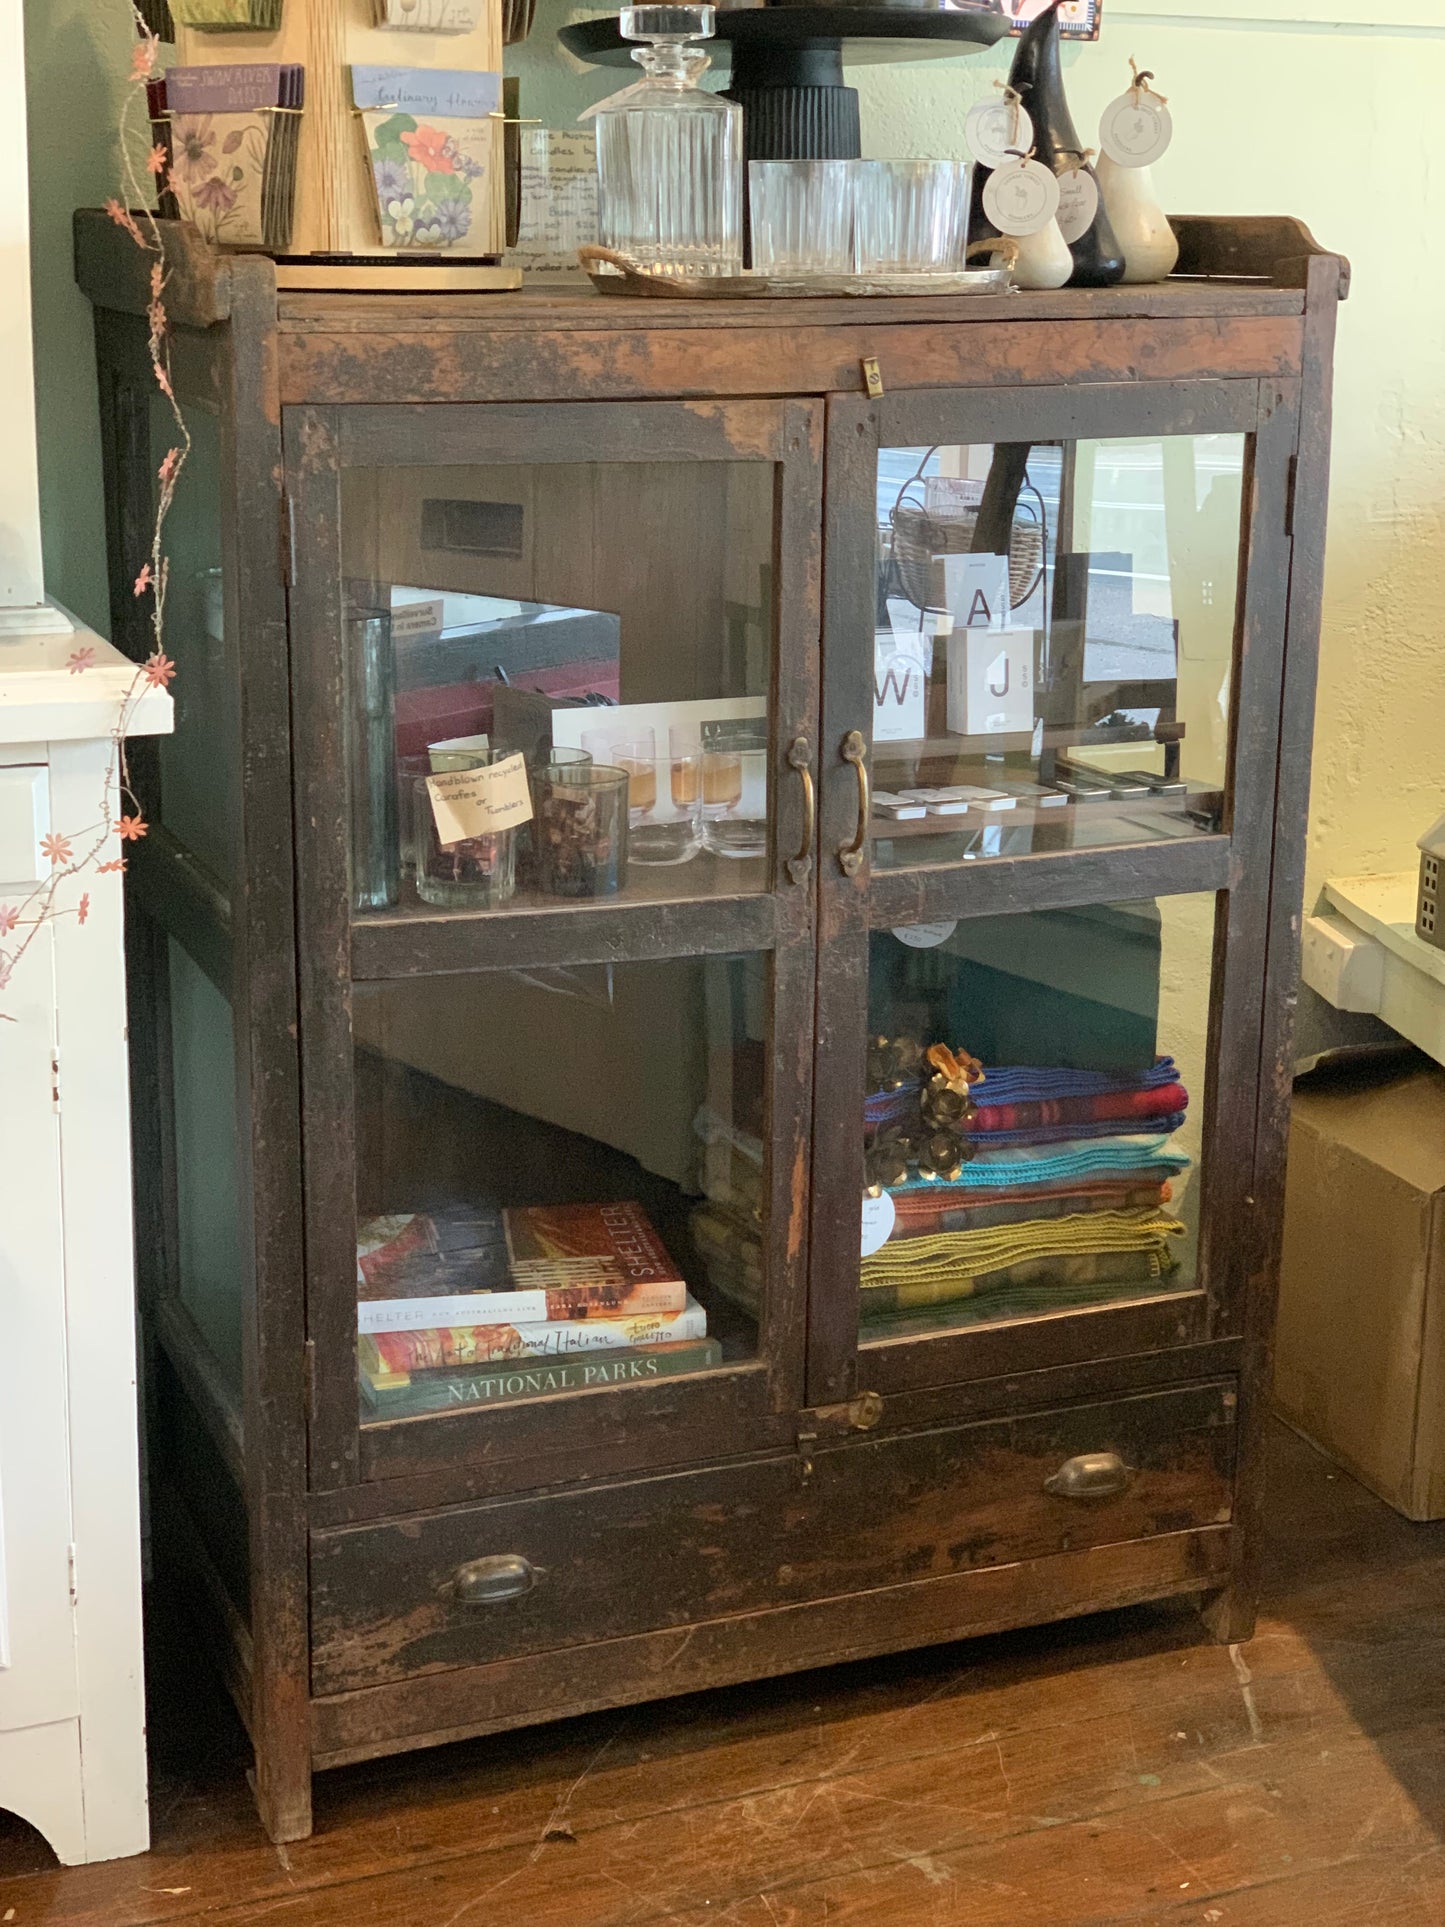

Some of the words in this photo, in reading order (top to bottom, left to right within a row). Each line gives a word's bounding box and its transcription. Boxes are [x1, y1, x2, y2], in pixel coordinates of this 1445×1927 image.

[967, 588, 992, 626] A
[874, 667, 912, 707] W
[990, 658, 1009, 698] J
[429, 774, 485, 790] Handblown
[488, 763, 523, 780] recycled
[434, 789, 477, 802] Carafes
[475, 798, 487, 806] or
[485, 799, 524, 815] Tumblers
[600, 1206, 655, 1277] SHELTER
[358, 1310, 424, 1324] HELTER
[555, 1330, 616, 1354] Italian
[448, 1370, 575, 1402] NATIONAL
[584, 1359, 659, 1385] PARKS
